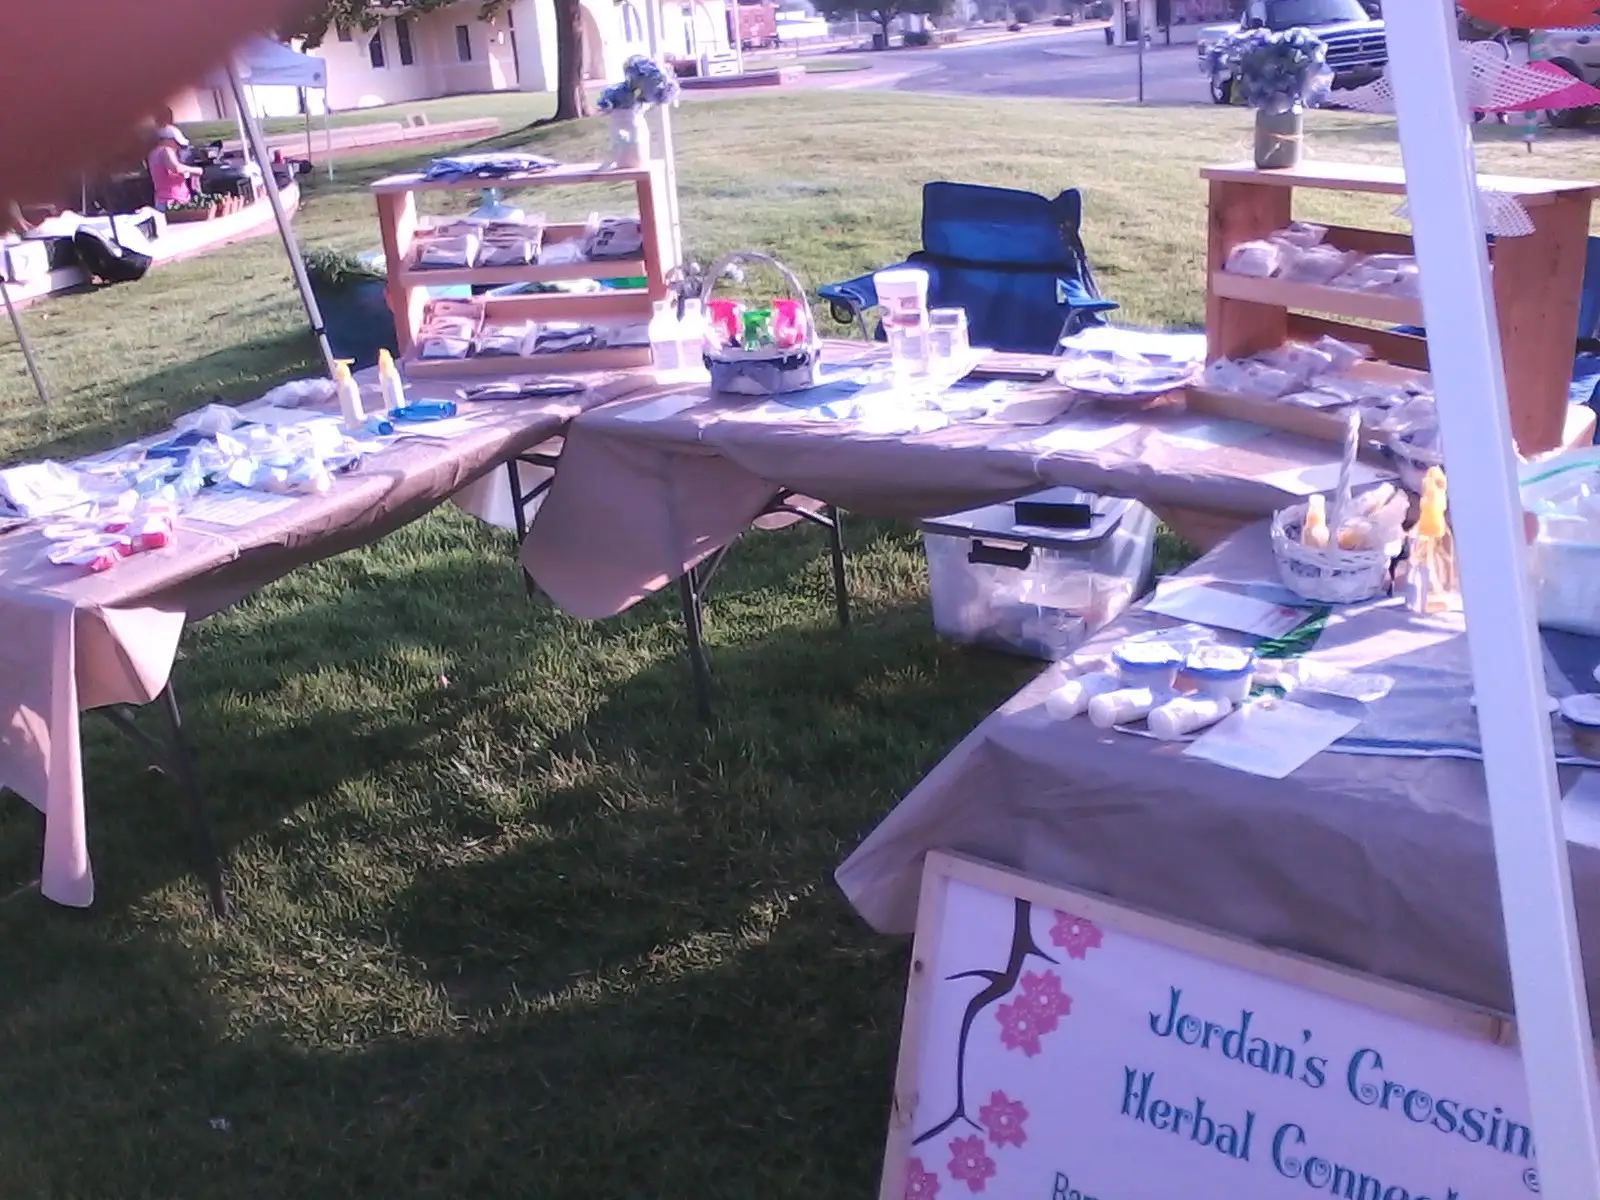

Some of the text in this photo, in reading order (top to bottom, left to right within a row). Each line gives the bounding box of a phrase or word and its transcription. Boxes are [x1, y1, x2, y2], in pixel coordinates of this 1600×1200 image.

[1149, 985, 1328, 1089] Jordan's
[1121, 1065, 1459, 1200] Herbal Conn
